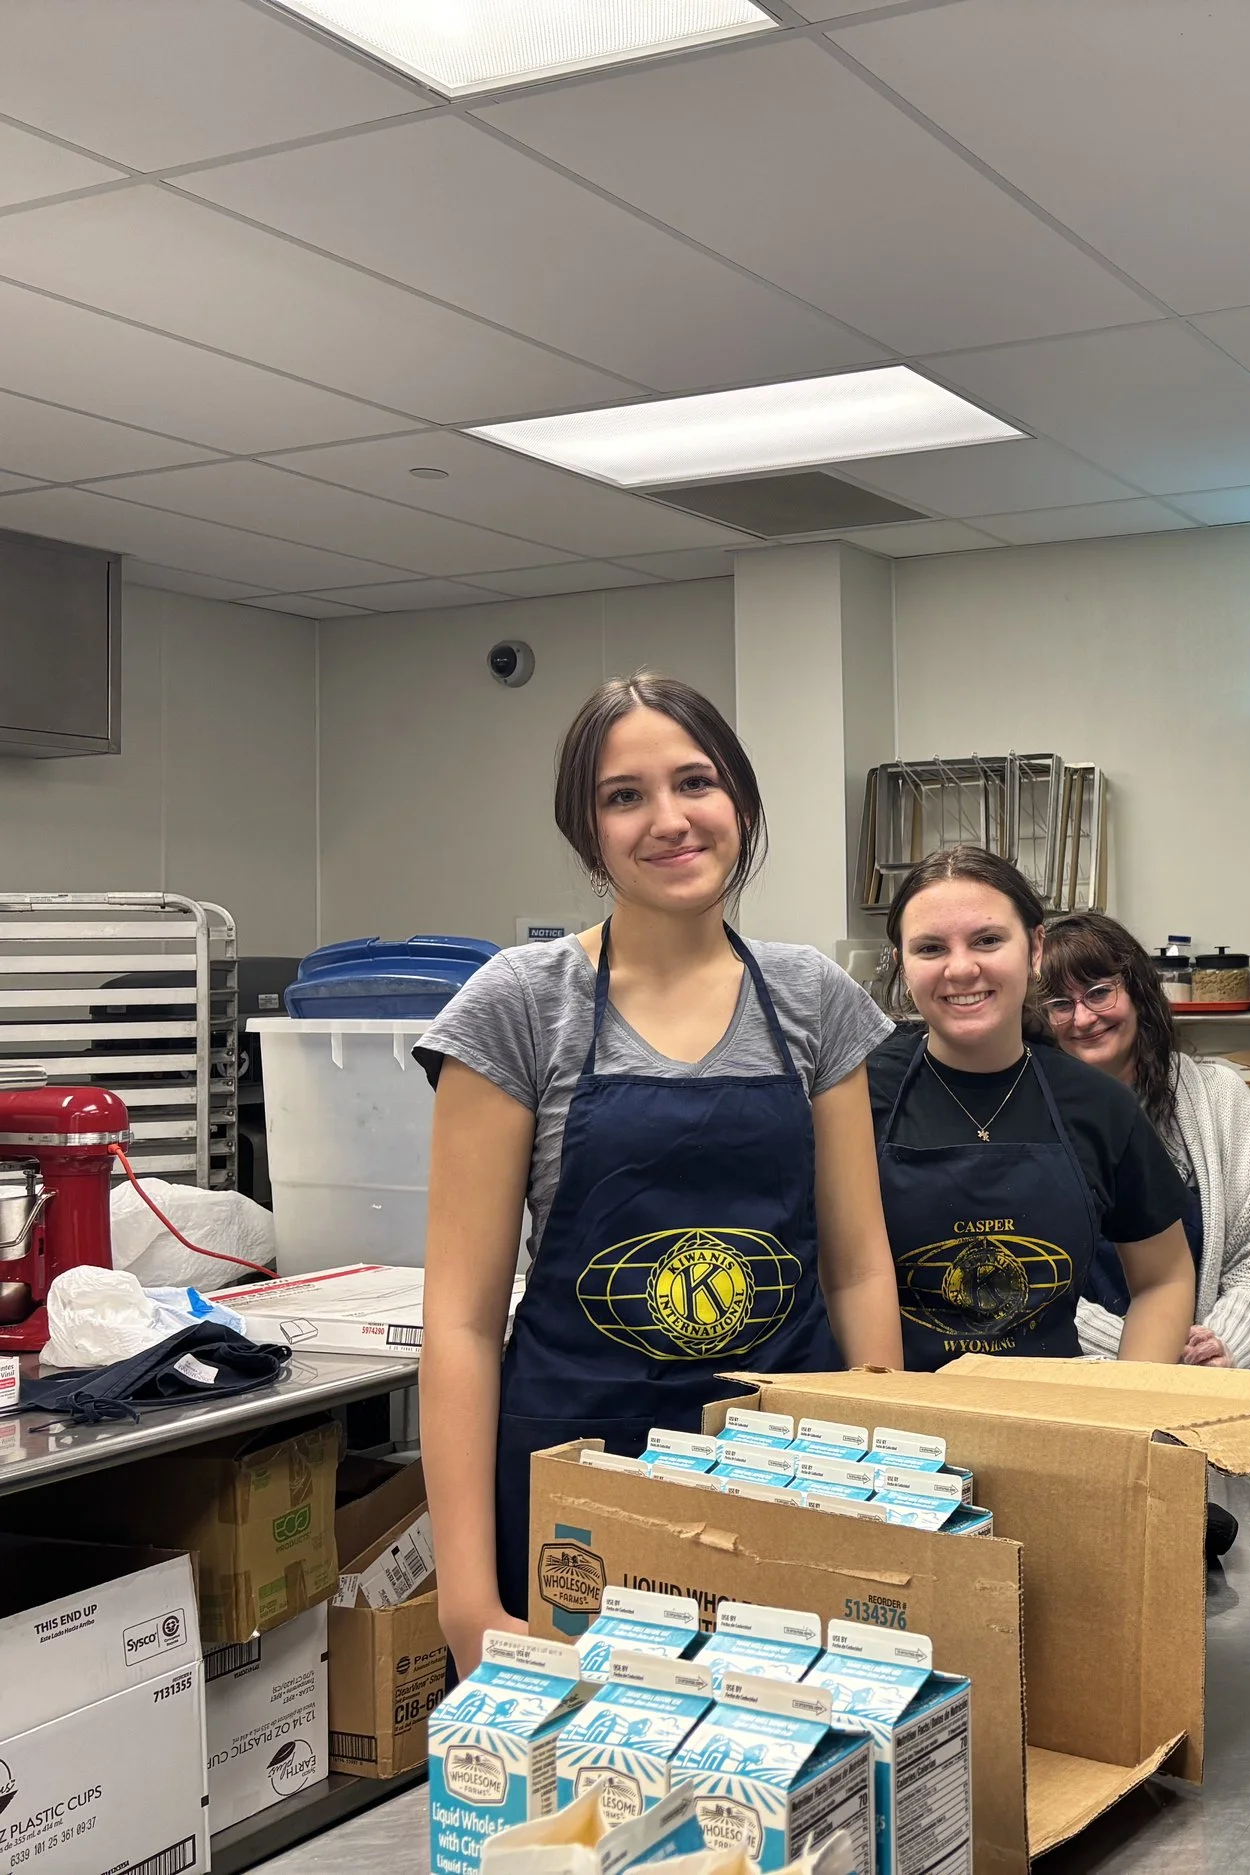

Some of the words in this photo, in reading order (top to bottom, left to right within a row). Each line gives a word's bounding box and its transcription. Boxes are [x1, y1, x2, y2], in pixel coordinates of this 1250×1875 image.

[531, 929, 563, 937] NOTICE
[954, 1219, 1014, 1233] CASPER
[668, 1252, 734, 1275] KIWANIS
[659, 1288, 744, 1336] INTERNATIONAL
[362, 1326, 384, 1334] 5974290
[944, 1337, 1016, 1353] WYOMING
[273, 1506, 310, 1542] ECO
[276, 1532, 308, 1553] PRODUCTS
[543, 1574, 600, 1600] WHOLESOME
[558, 1592, 584, 1604] FARMS
[868, 1595, 901, 1609] REORDER
[34, 1618, 58, 1635] THIS
[60, 1610, 82, 1626] END
[84, 1604, 98, 1617] UP
[844, 1598, 907, 1630] 5134376
[51, 1630, 64, 1639] Lado
[64, 1624, 78, 1634] Hacia
[79, 1619, 94, 1629] Arriba
[126, 1632, 156, 1652] Sysco
[414, 1645, 447, 1665] PACTI
[153, 1677, 192, 1703] 7131355
[298, 1685, 315, 1697] CLEAR
[274, 1722, 290, 1737] OZ
[292, 1710, 316, 1729] 12-14
[230, 1730, 272, 1757] PLASTIC
[960, 1734, 968, 1749] 70
[207, 1751, 228, 1769] CUP
[271, 1752, 295, 1780] plus
[286, 1756, 316, 1778] EARTH
[451, 1770, 502, 1794] WHOLESOME
[464, 1786, 487, 1796] FARMS
[602, 1796, 636, 1816] LESOME
[859, 1793, 868, 1808] 70
[0, 1828, 7, 1843] Z
[10, 1802, 65, 1838] PLASTIC
[67, 1785, 102, 1810] CUPS
[432, 1802, 460, 1829] Liquid
[461, 1810, 496, 1834] Whole
[606, 1810, 620, 1820] RMS
[4, 1842, 12, 1851] de
[14, 1836, 26, 1846] 355
[26, 1831, 36, 1840] mL
[54, 1818, 63, 1827] mL
[439, 1830, 459, 1852] with
[461, 1836, 483, 1857] Citri
[705, 1825, 756, 1848] HOLESOE
[10, 1848, 30, 1867] 6339
[48, 1834, 58, 1849] 25
[61, 1828, 74, 1842] 361
[437, 1853, 461, 1873] Liquid
